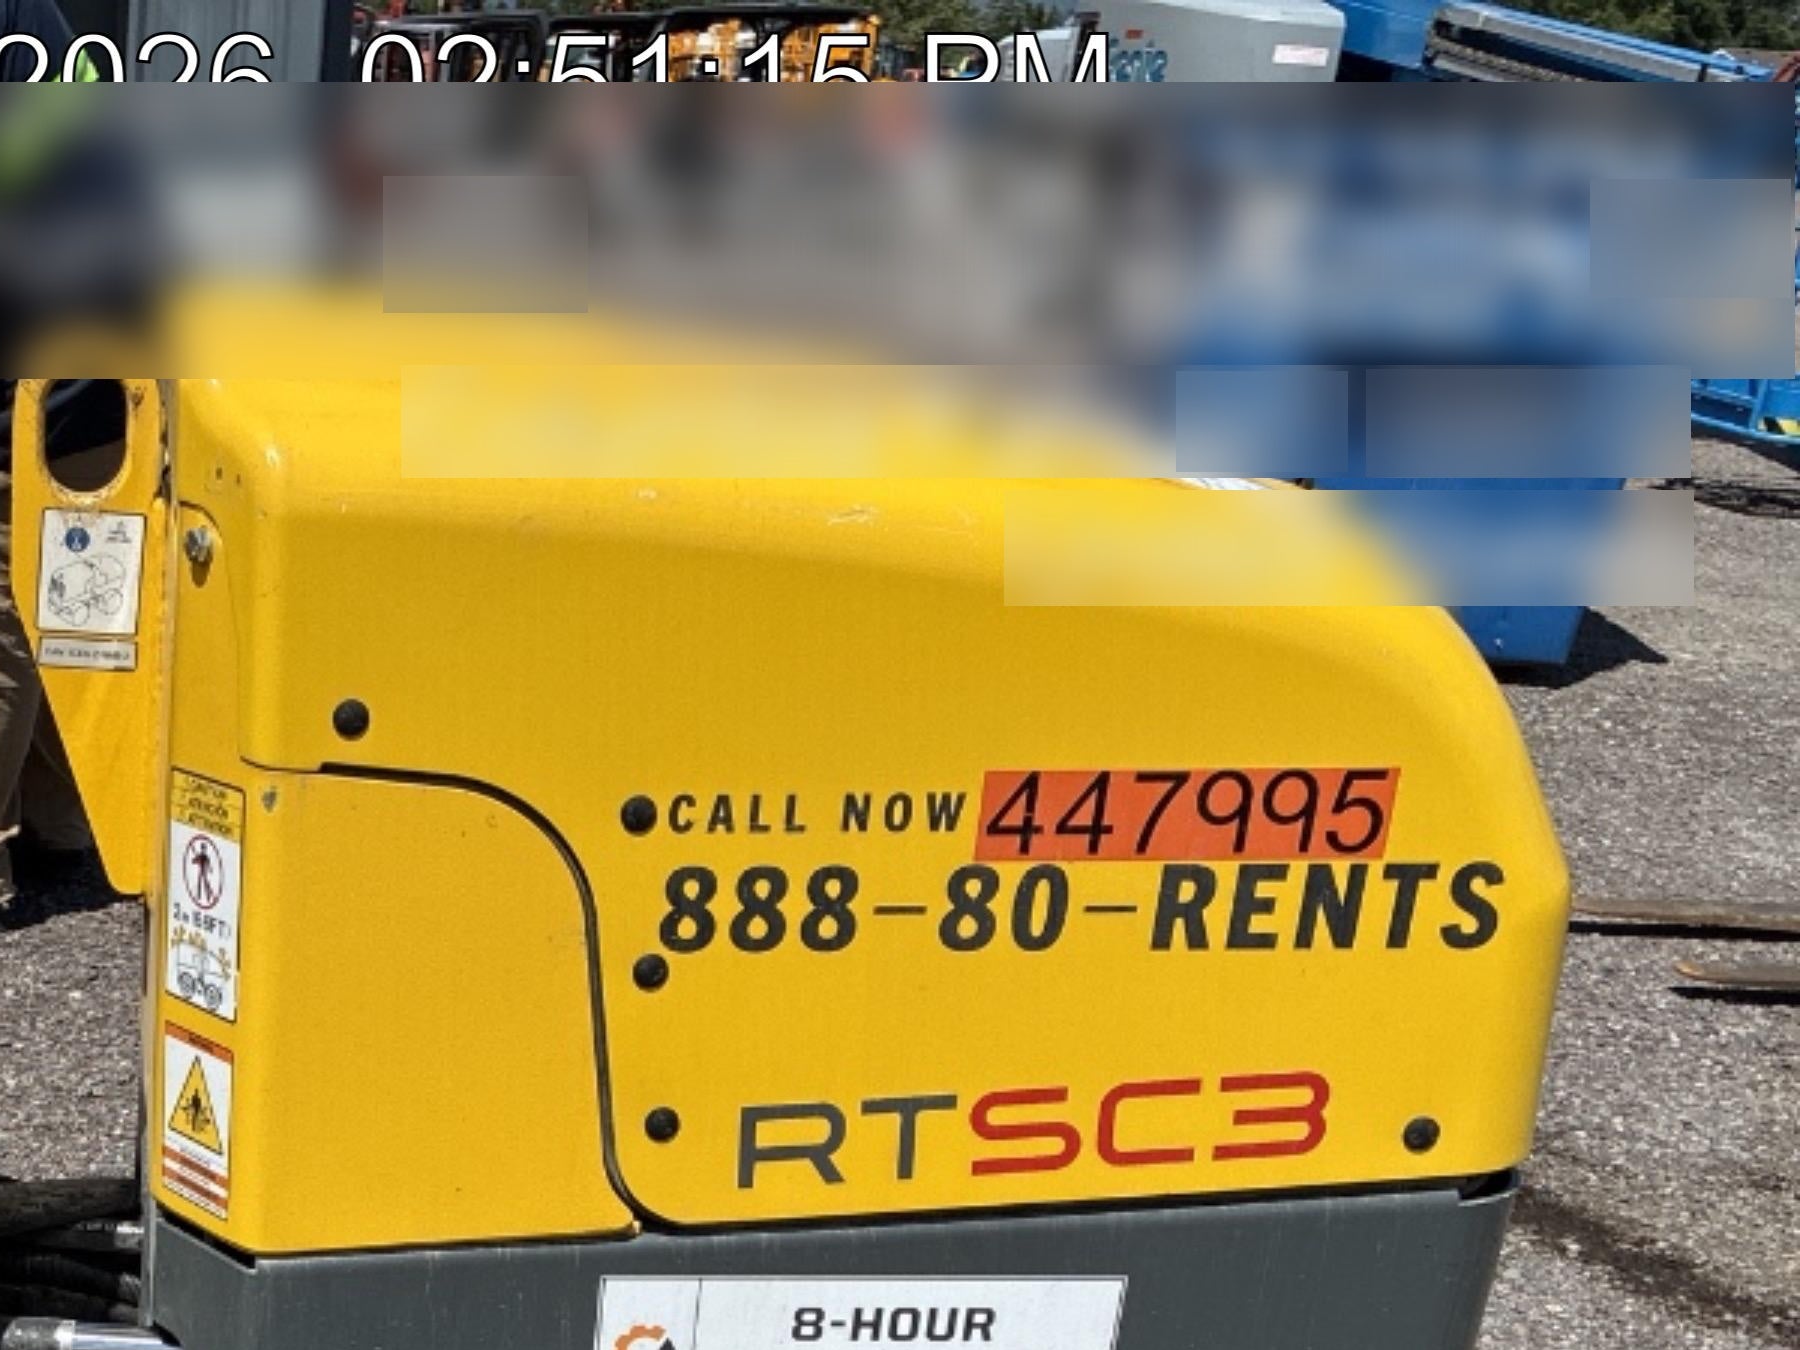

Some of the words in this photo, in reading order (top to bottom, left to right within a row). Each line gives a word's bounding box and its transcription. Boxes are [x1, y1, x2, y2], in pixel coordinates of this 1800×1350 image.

[668, 793, 808, 835] CALL
[839, 791, 968, 833] NOW
[986, 768, 1390, 856] 447995
[658, 861, 1506, 954] 888-80-RENTS
[791, 1307, 997, 1342] 8-HOUR
